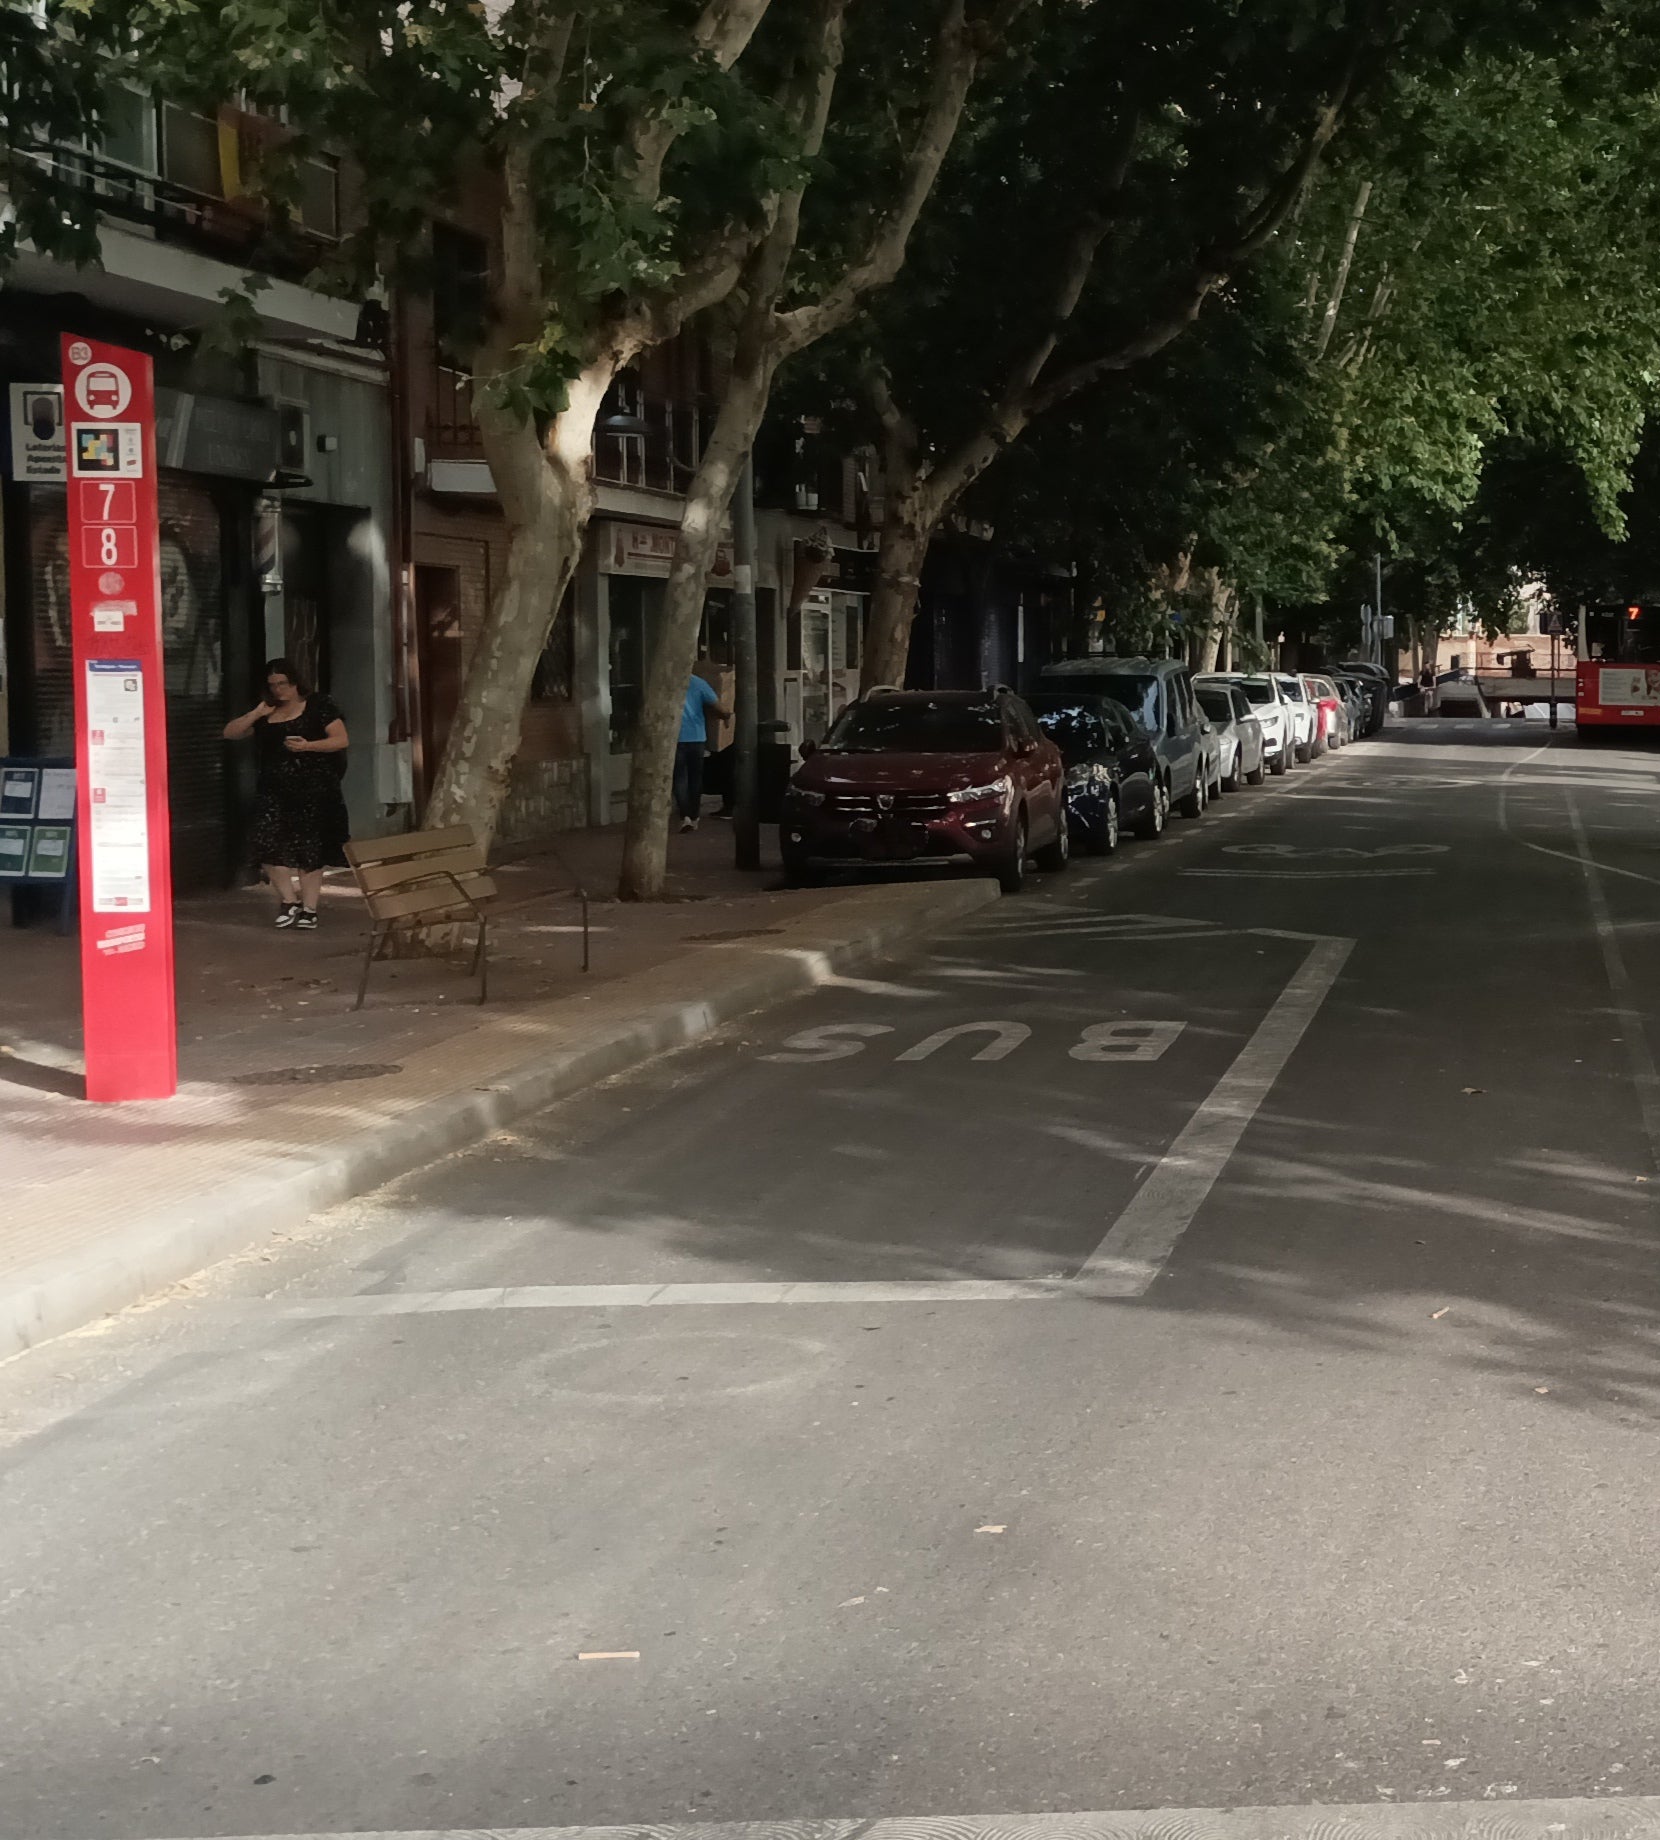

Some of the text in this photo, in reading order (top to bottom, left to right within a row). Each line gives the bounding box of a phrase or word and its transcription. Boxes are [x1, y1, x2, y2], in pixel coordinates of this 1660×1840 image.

[99, 483, 116, 521] 7
[101, 527, 118, 566] 8
[1628, 607, 1639, 620] 7
[756, 1020, 1188, 1062] BUS
